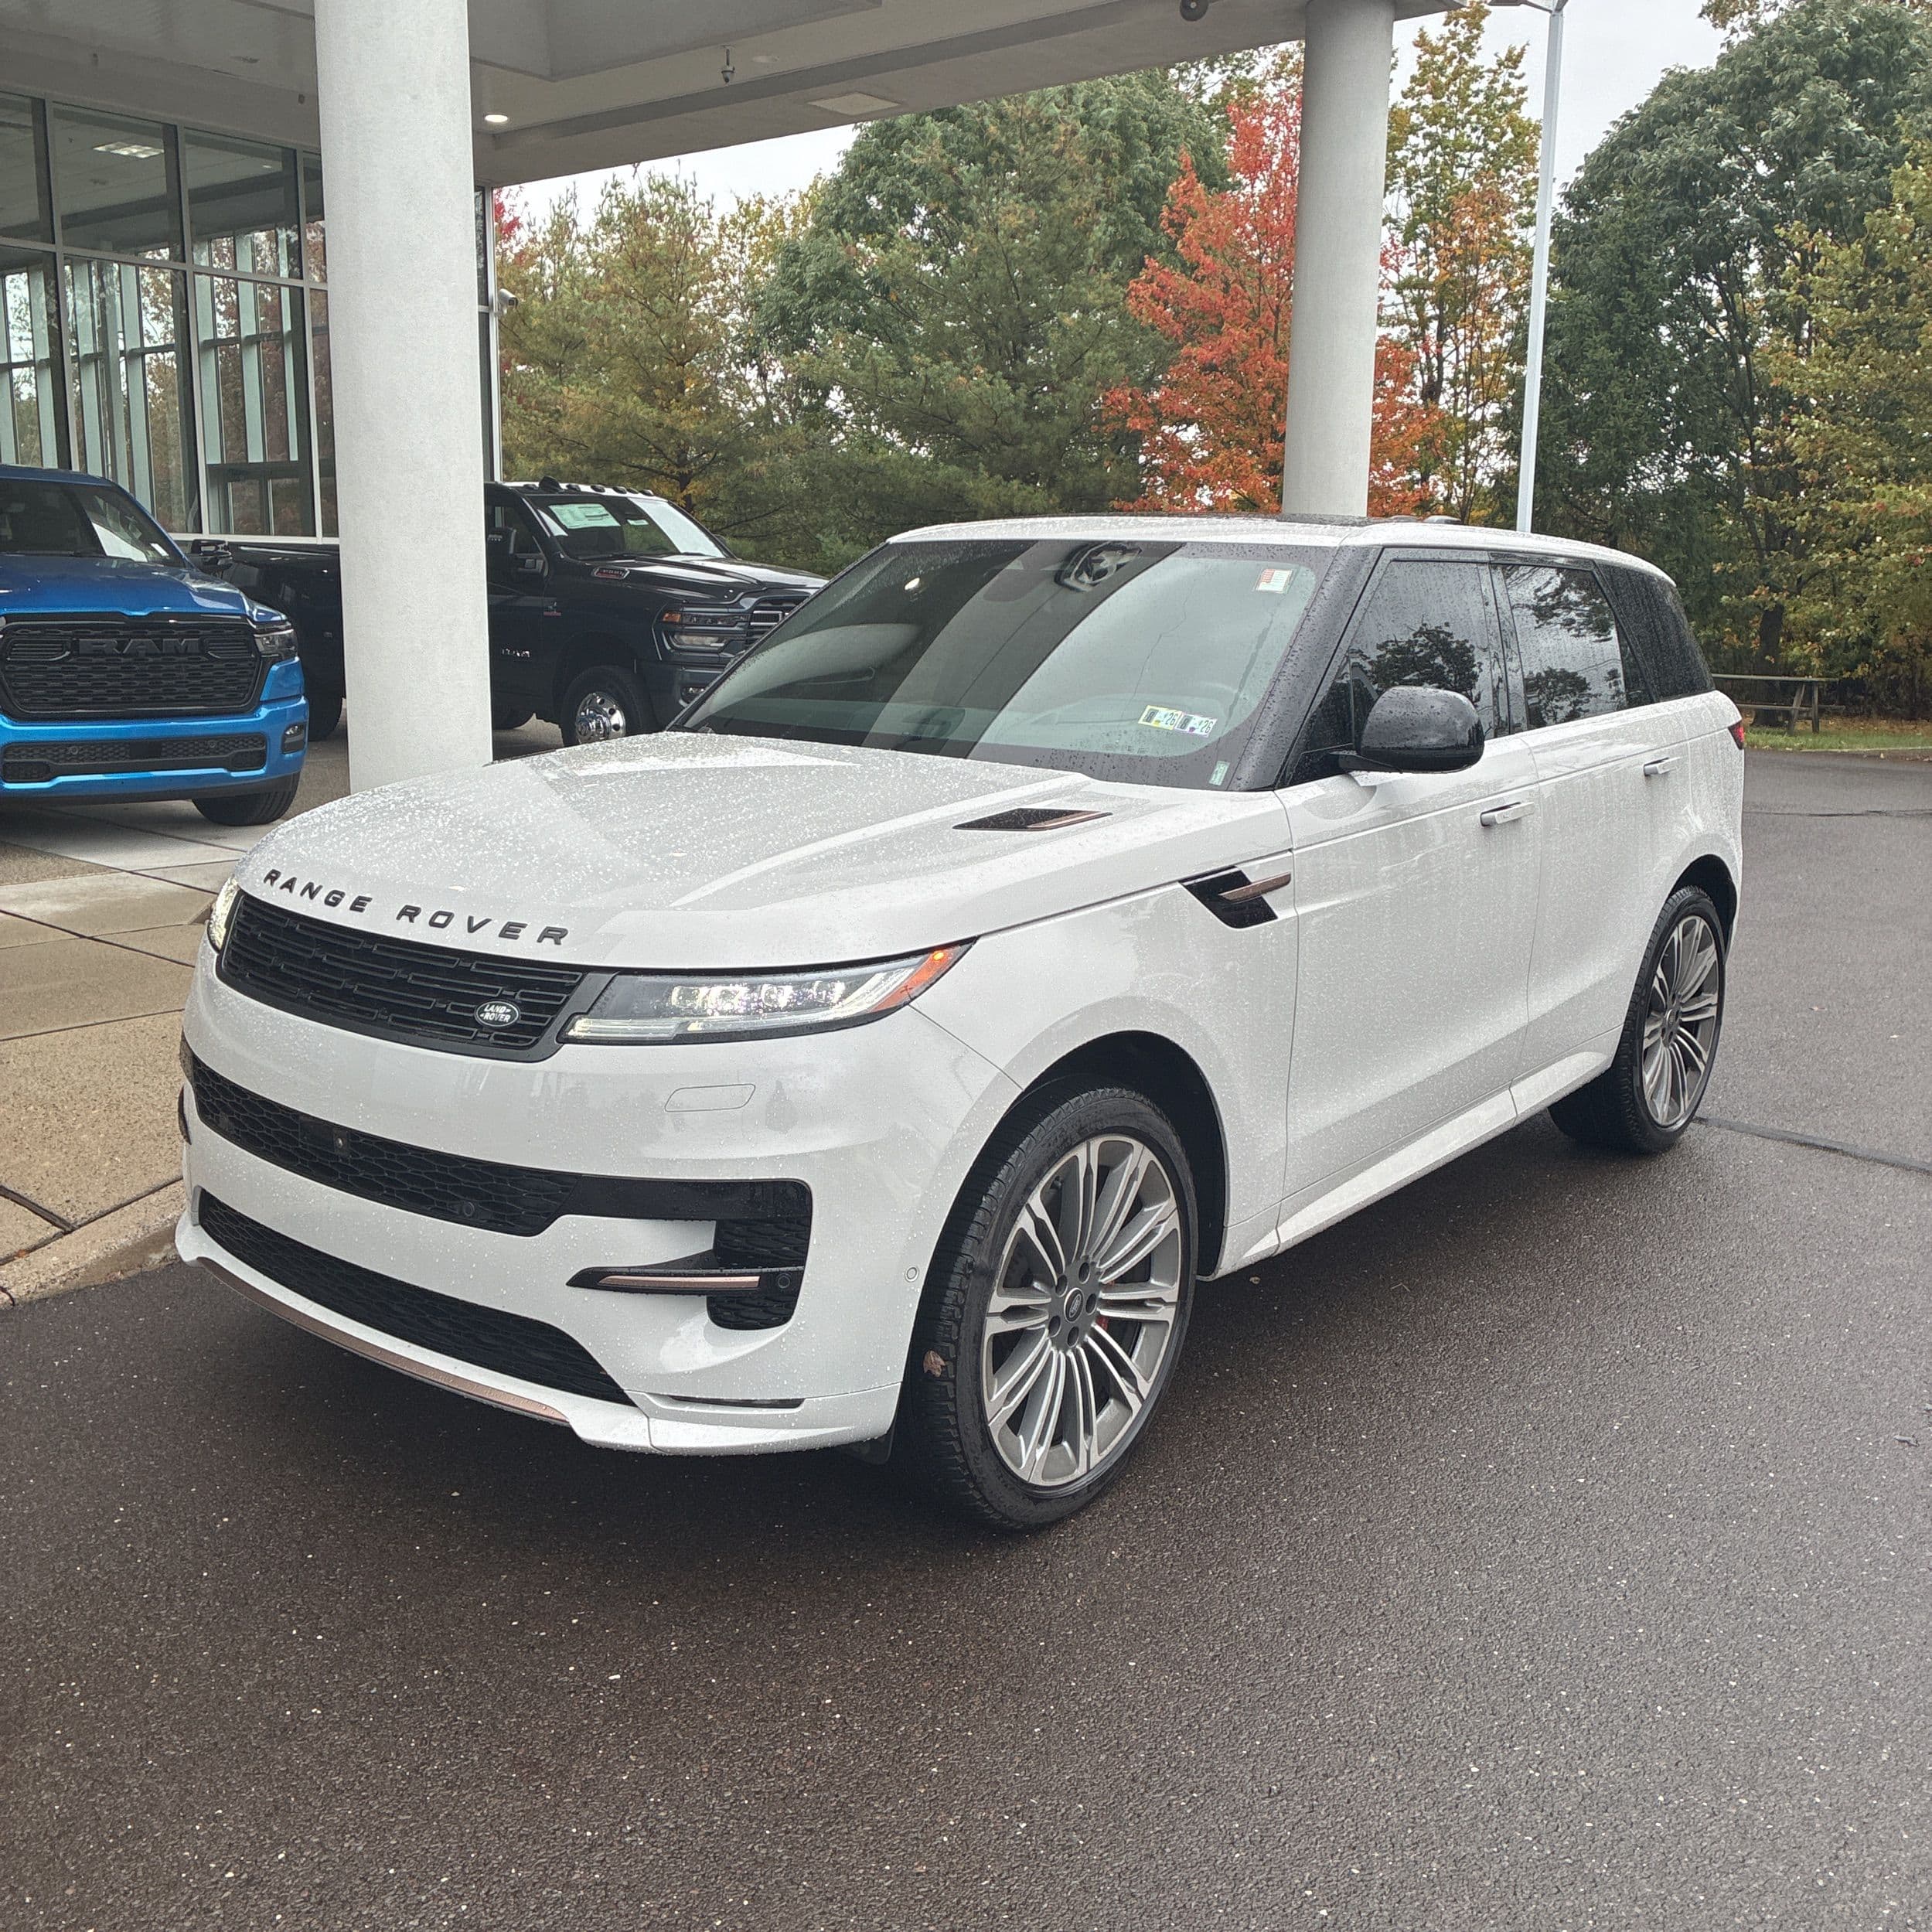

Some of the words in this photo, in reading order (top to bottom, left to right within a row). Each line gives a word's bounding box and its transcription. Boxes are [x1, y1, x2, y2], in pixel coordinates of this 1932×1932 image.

[79, 638, 200, 655] RAM
[1180, 717, 1189, 730] 8
[264, 868, 373, 913] RANGE
[396, 904, 569, 946] ROVER
[484, 1004, 506, 1013] LAND
[483, 1012, 511, 1022] ROVER
